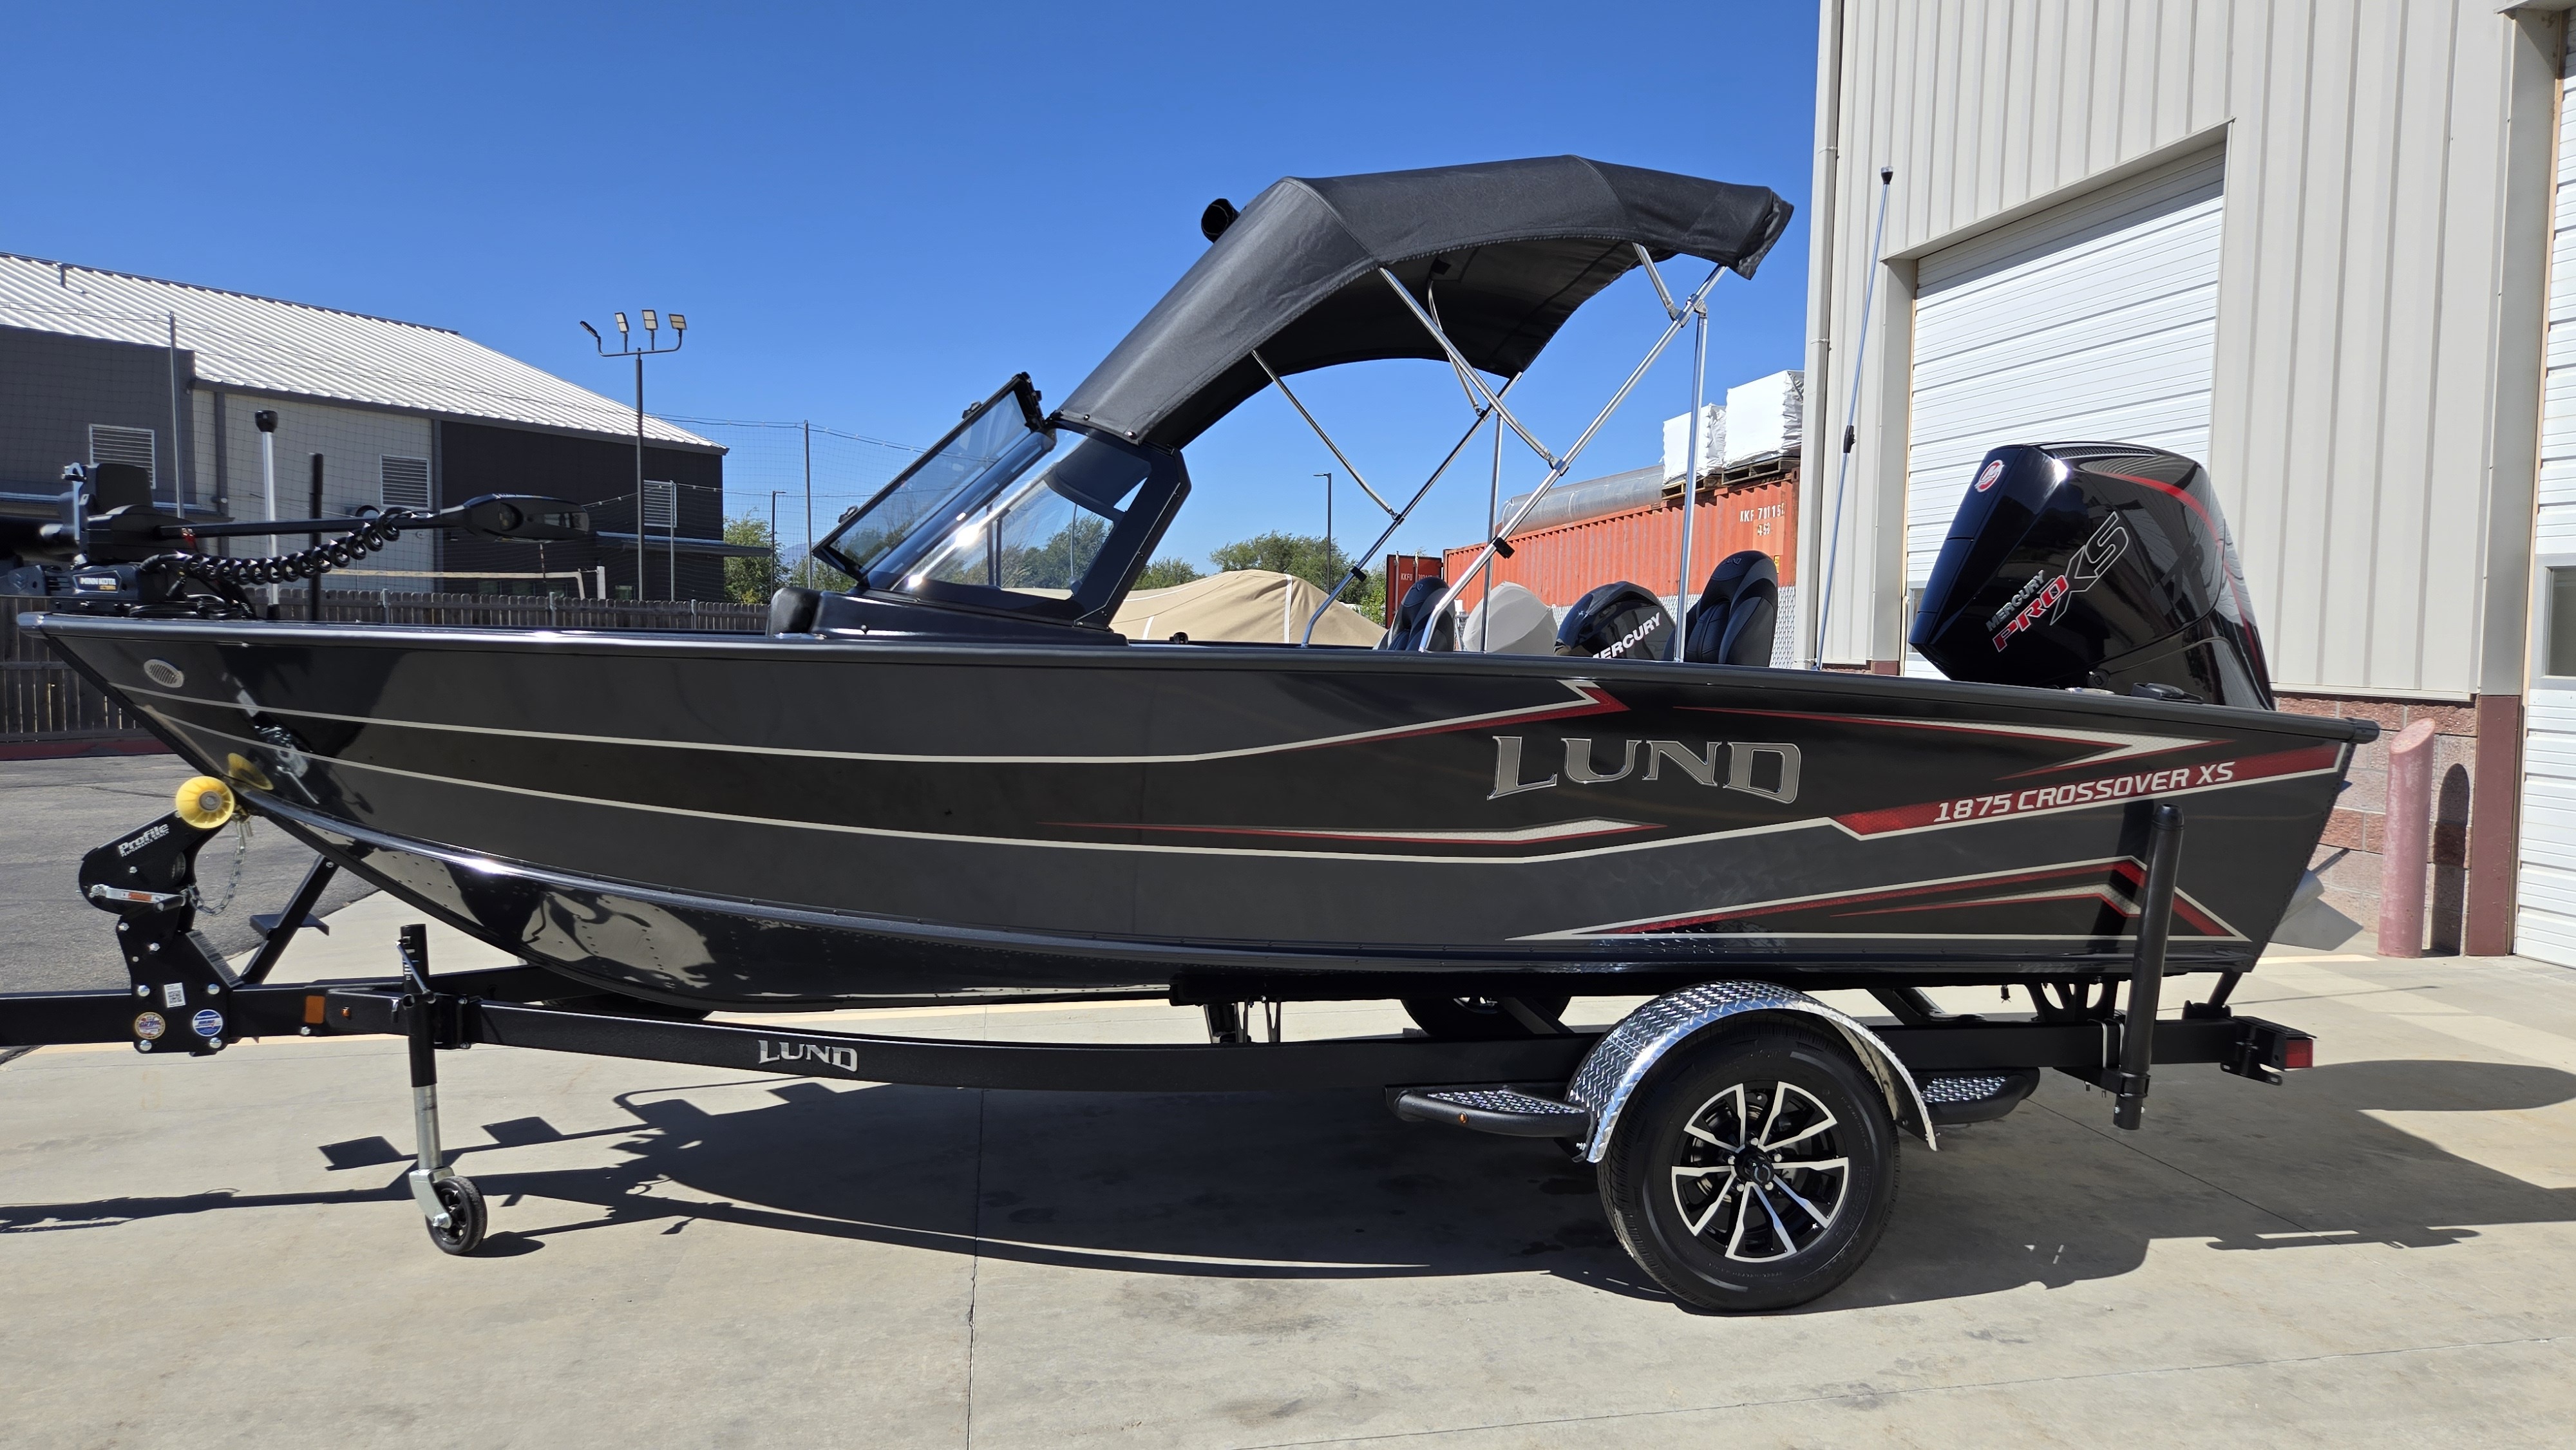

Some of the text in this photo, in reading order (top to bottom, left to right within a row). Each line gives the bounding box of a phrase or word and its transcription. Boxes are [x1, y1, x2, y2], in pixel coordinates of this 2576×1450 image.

[1985, 569, 2045, 632] MERCURY
[1993, 511, 2129, 652] PRO XS
[1486, 735, 1802, 804] LUND
[1933, 761, 2235, 823] 1875 CROSSOVER XS
[118, 824, 169, 855] Profile
[757, 1040, 858, 1073] LUND
